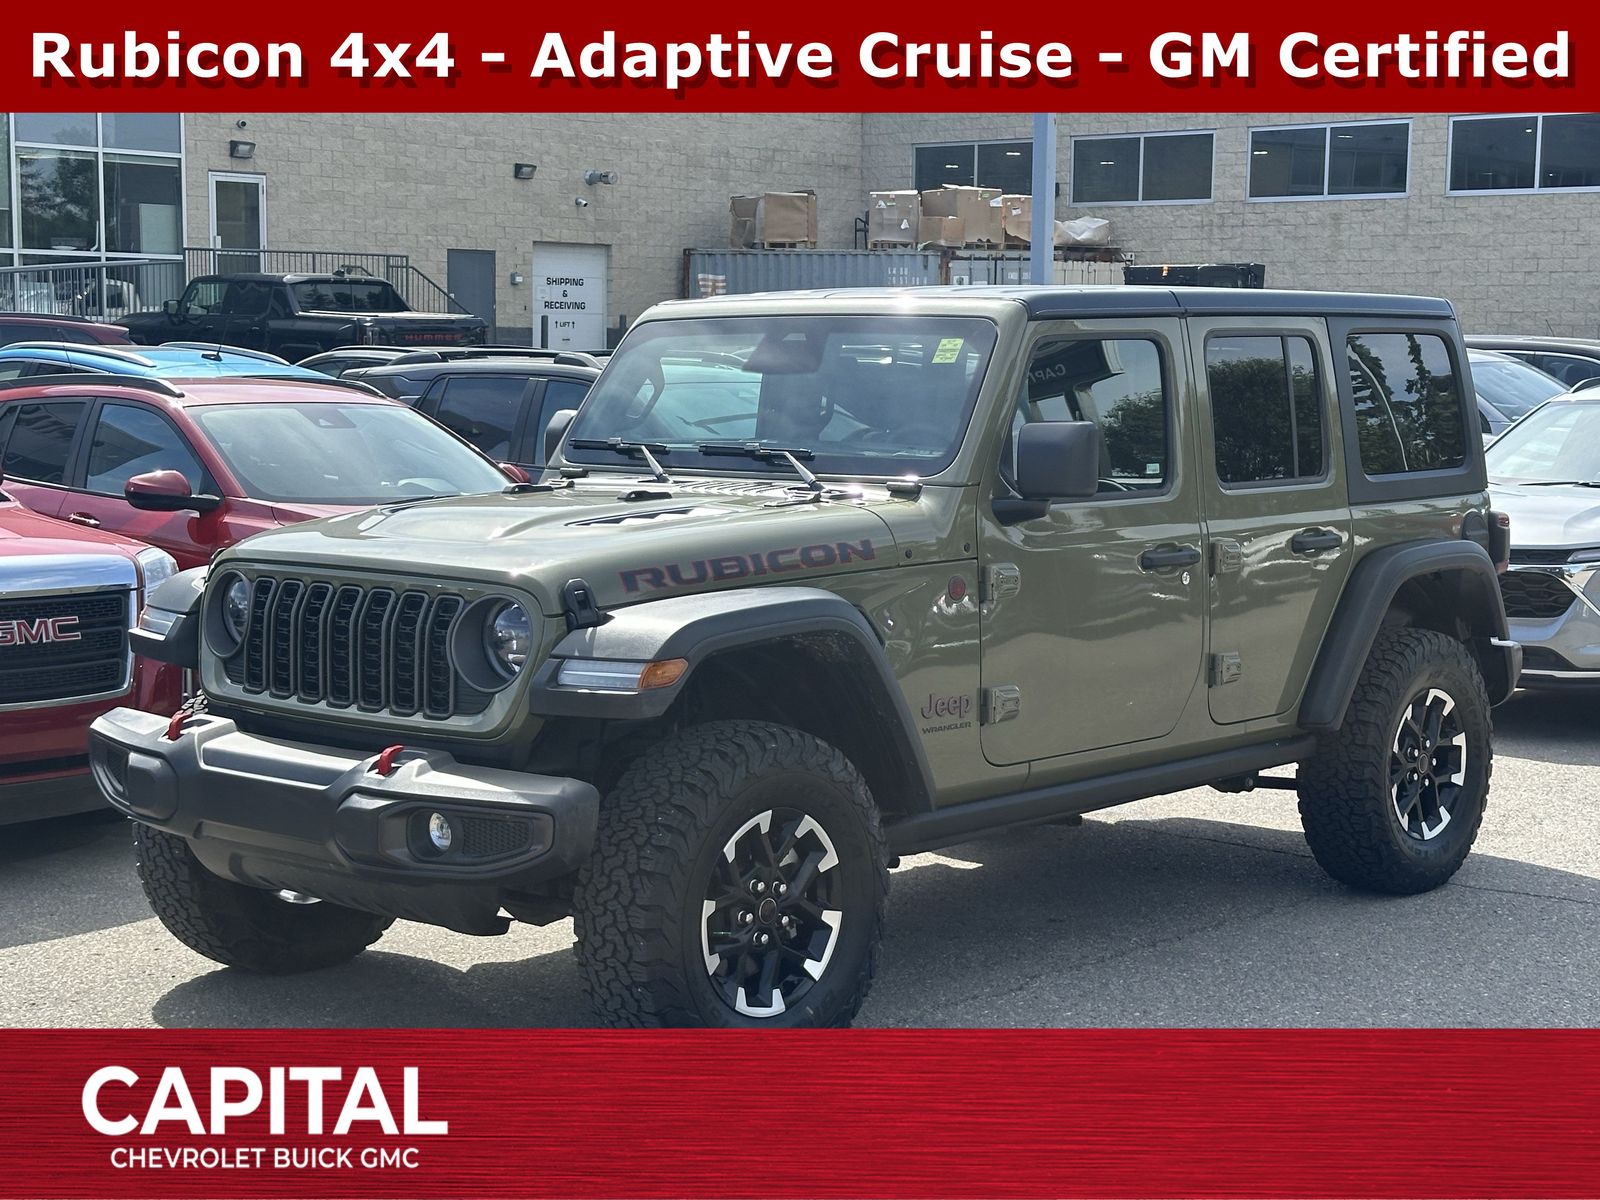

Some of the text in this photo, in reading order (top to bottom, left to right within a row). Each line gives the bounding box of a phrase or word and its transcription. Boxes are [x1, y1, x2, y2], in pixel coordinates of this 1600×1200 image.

[546, 277, 585, 287] SHIPPING
[562, 289, 568, 298] &
[544, 301, 586, 310] RECEIVING
[619, 539, 876, 593] RUBICON
[920, 693, 971, 720] Jeep
[921, 721, 972, 735] WRANGLER
